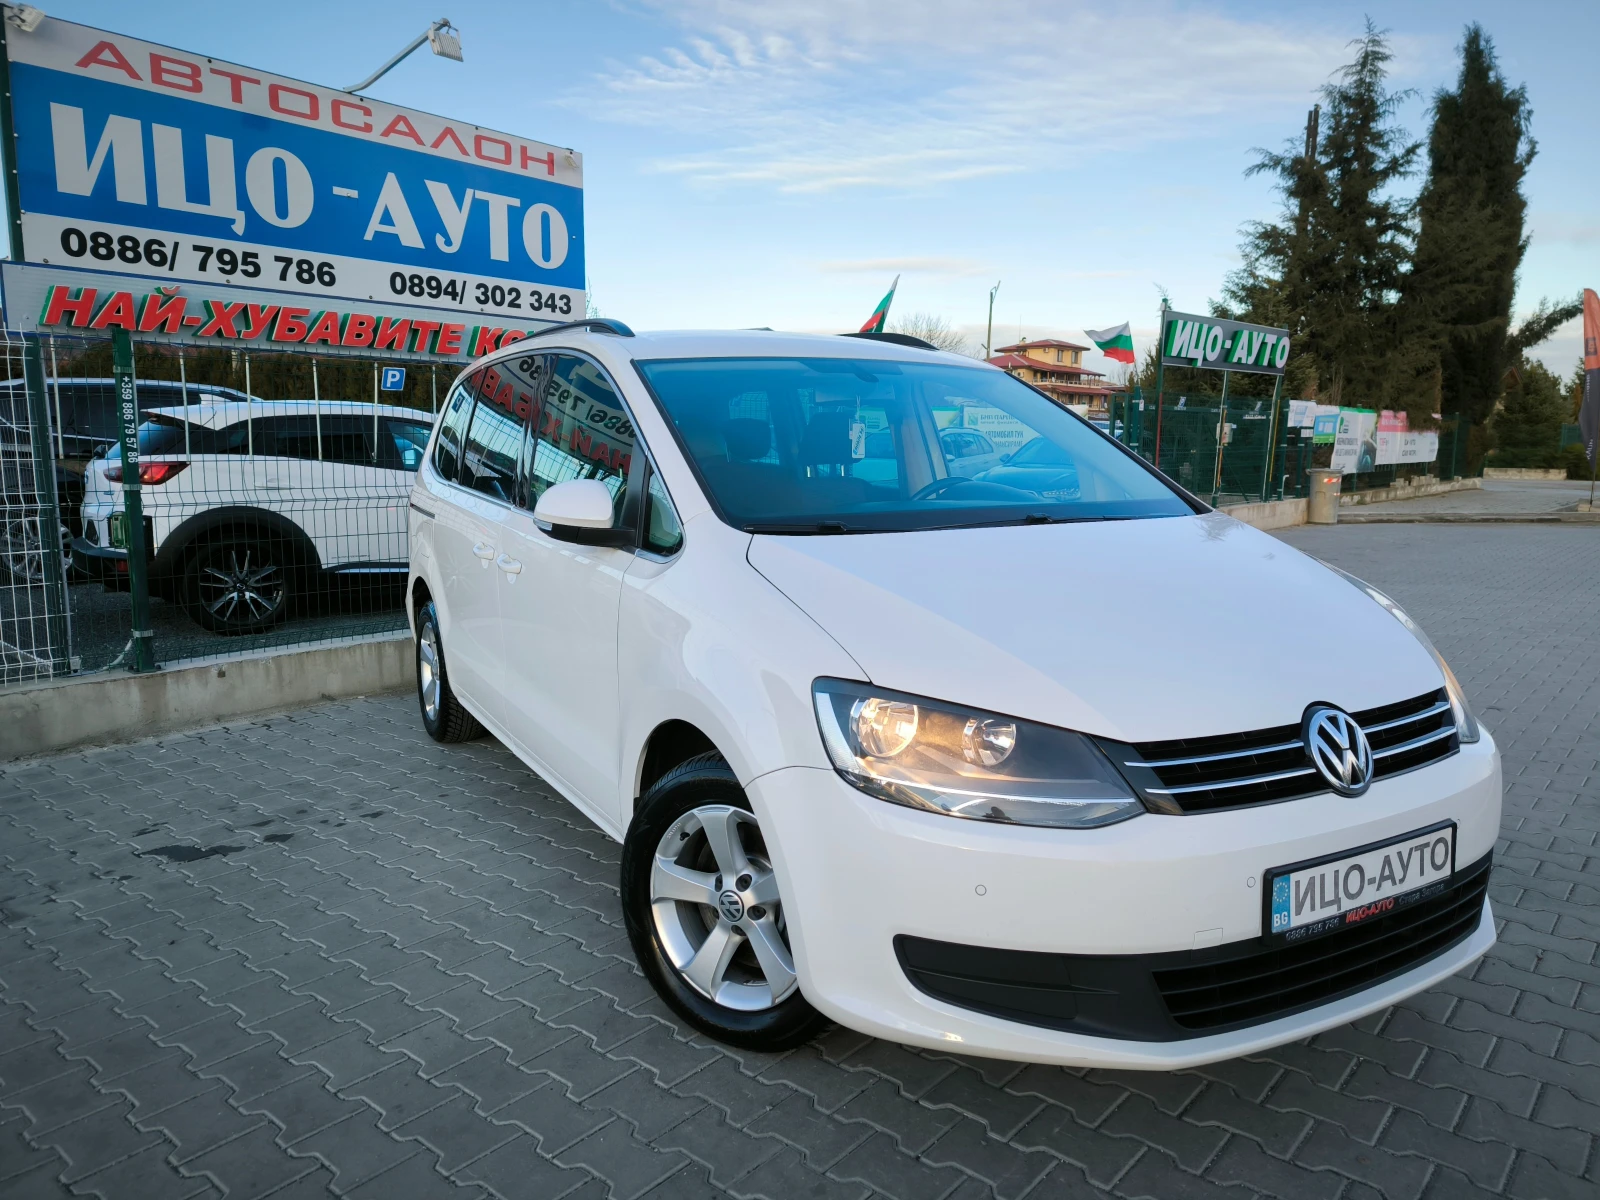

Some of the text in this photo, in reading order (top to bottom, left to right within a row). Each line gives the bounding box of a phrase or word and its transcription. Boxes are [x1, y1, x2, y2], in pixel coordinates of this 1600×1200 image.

[75, 40, 555, 177] АВТОСАЛОН
[60, 227, 336, 287] 0886/ 795 786
[42, 285, 466, 355] НАЙ-ХУБАВИТЕ
[389, 271, 572, 315] 0894/ 302 343
[1168, 319, 1291, 369] ИЦО-АУТО
[121, 376, 138, 463] +359 886 79 57 86
[1294, 836, 1450, 917] ИЦО-АУТО
[1273, 911, 1289, 927] BG
[1345, 896, 1395, 924] ИЦО-АУТО
